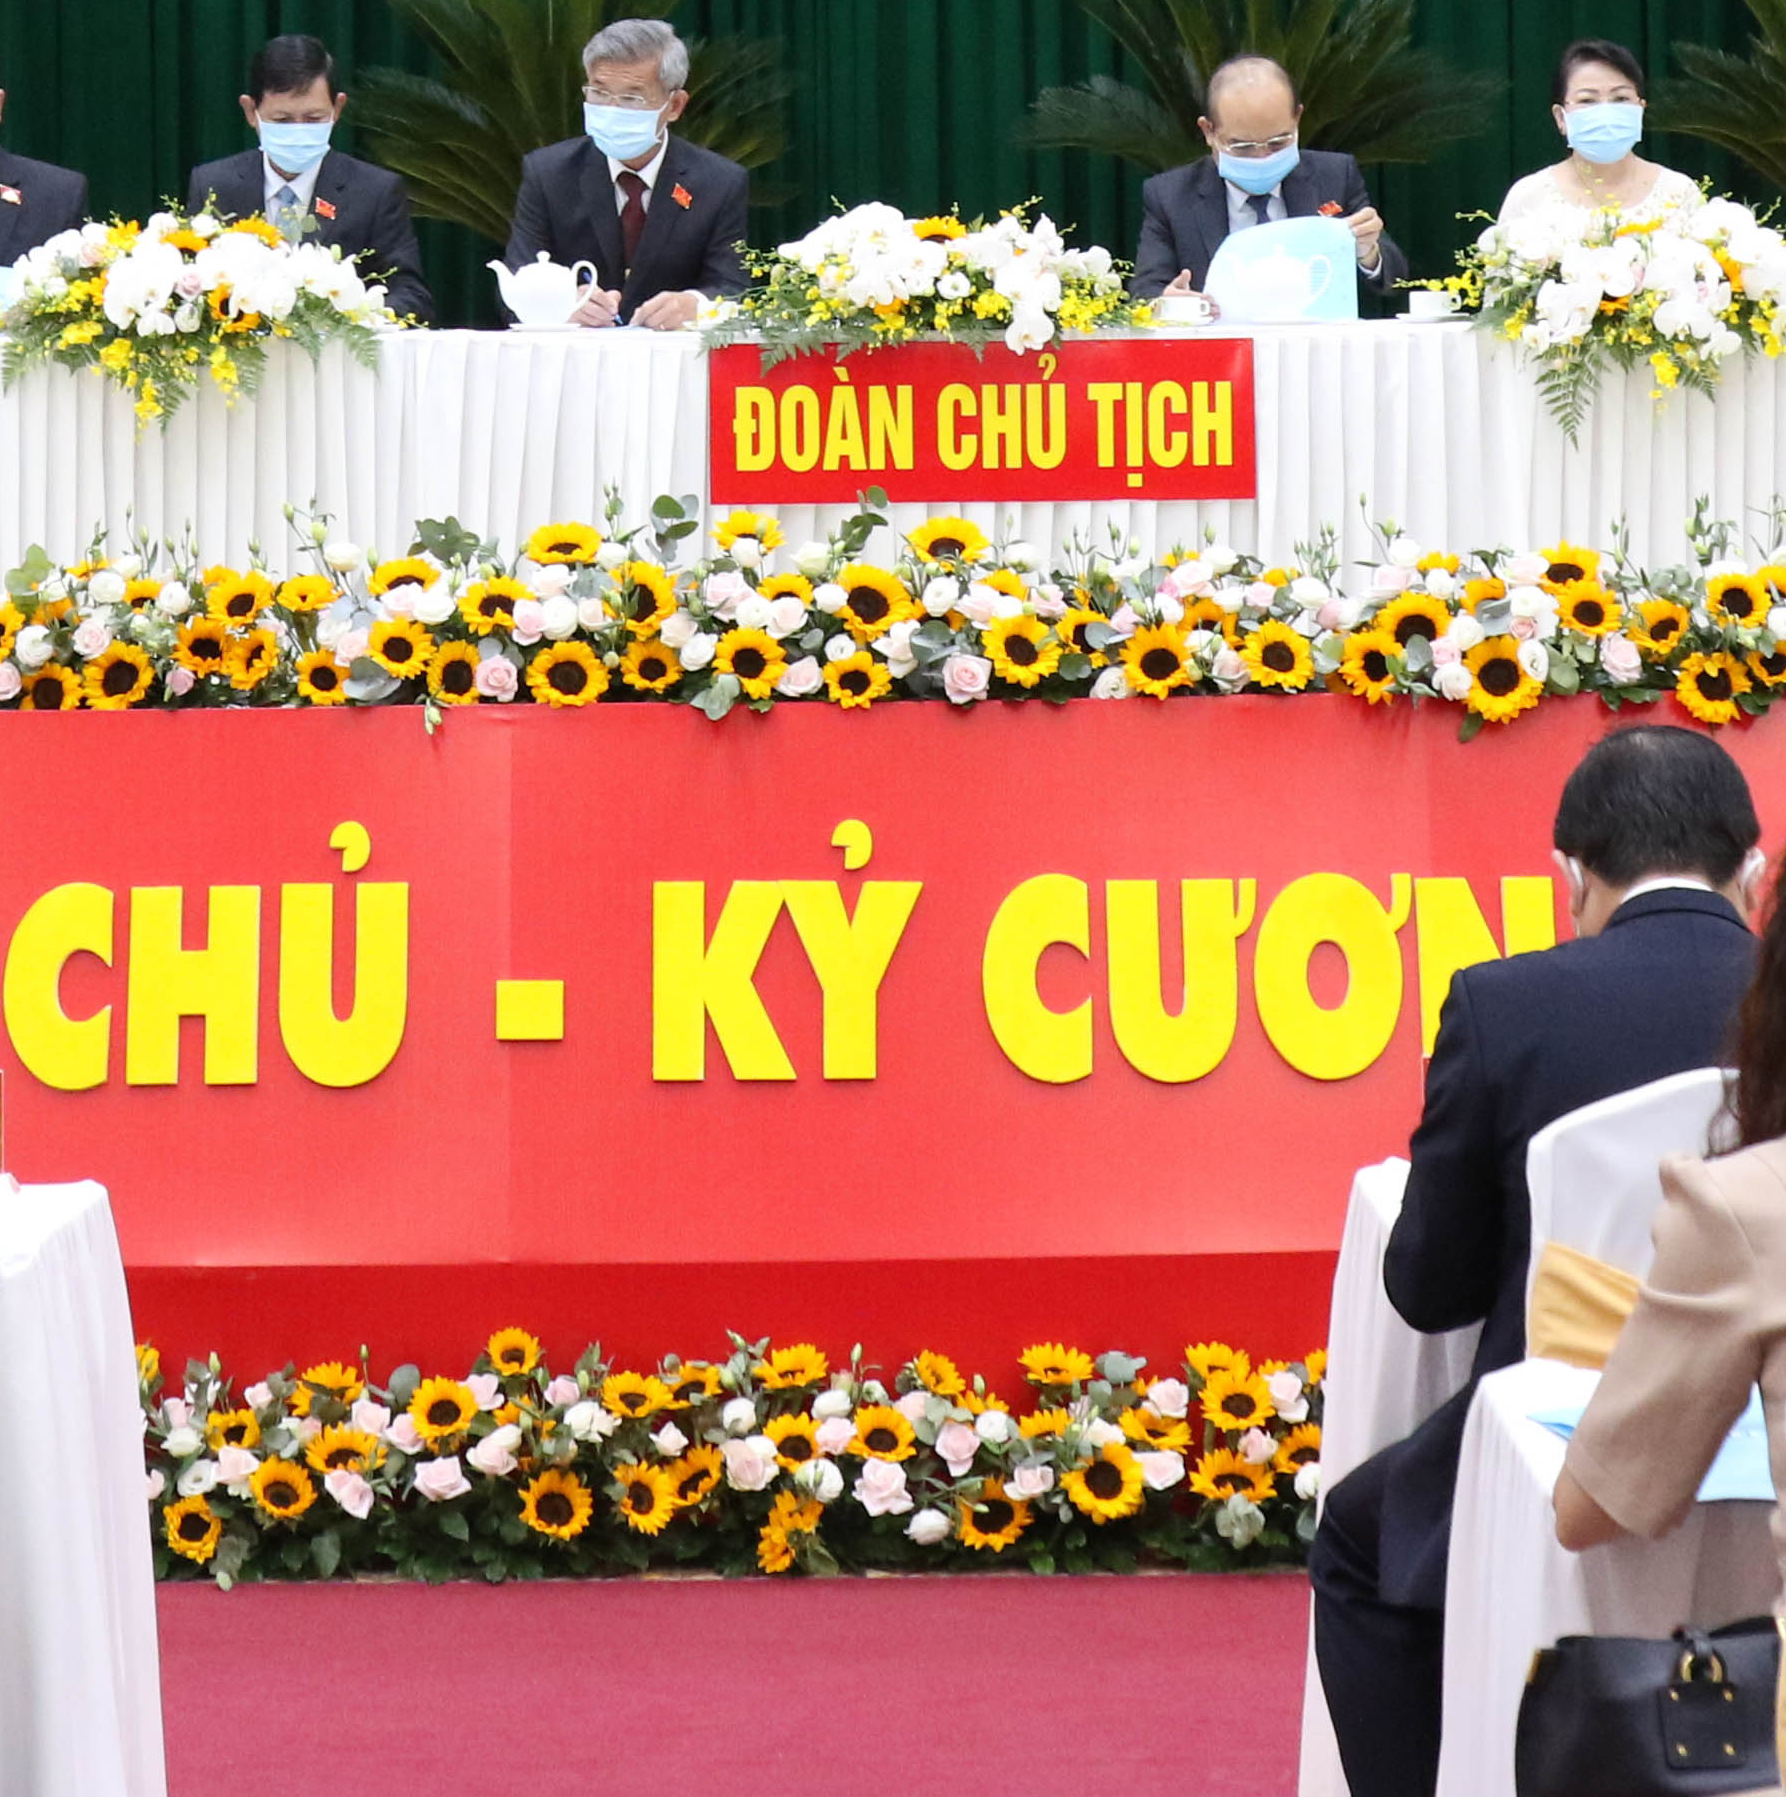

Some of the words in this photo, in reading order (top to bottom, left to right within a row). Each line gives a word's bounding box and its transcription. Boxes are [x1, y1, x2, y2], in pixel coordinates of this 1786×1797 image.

[733, 366, 916, 472] ĐOÀN
[937, 353, 1068, 472] CHỦ
[1088, 380, 1234, 488] TỊCH
[2, 820, 411, 1091] CHỦ
[652, 819, 924, 1082] KỶ
[982, 872, 1558, 1084] CƯƠN
